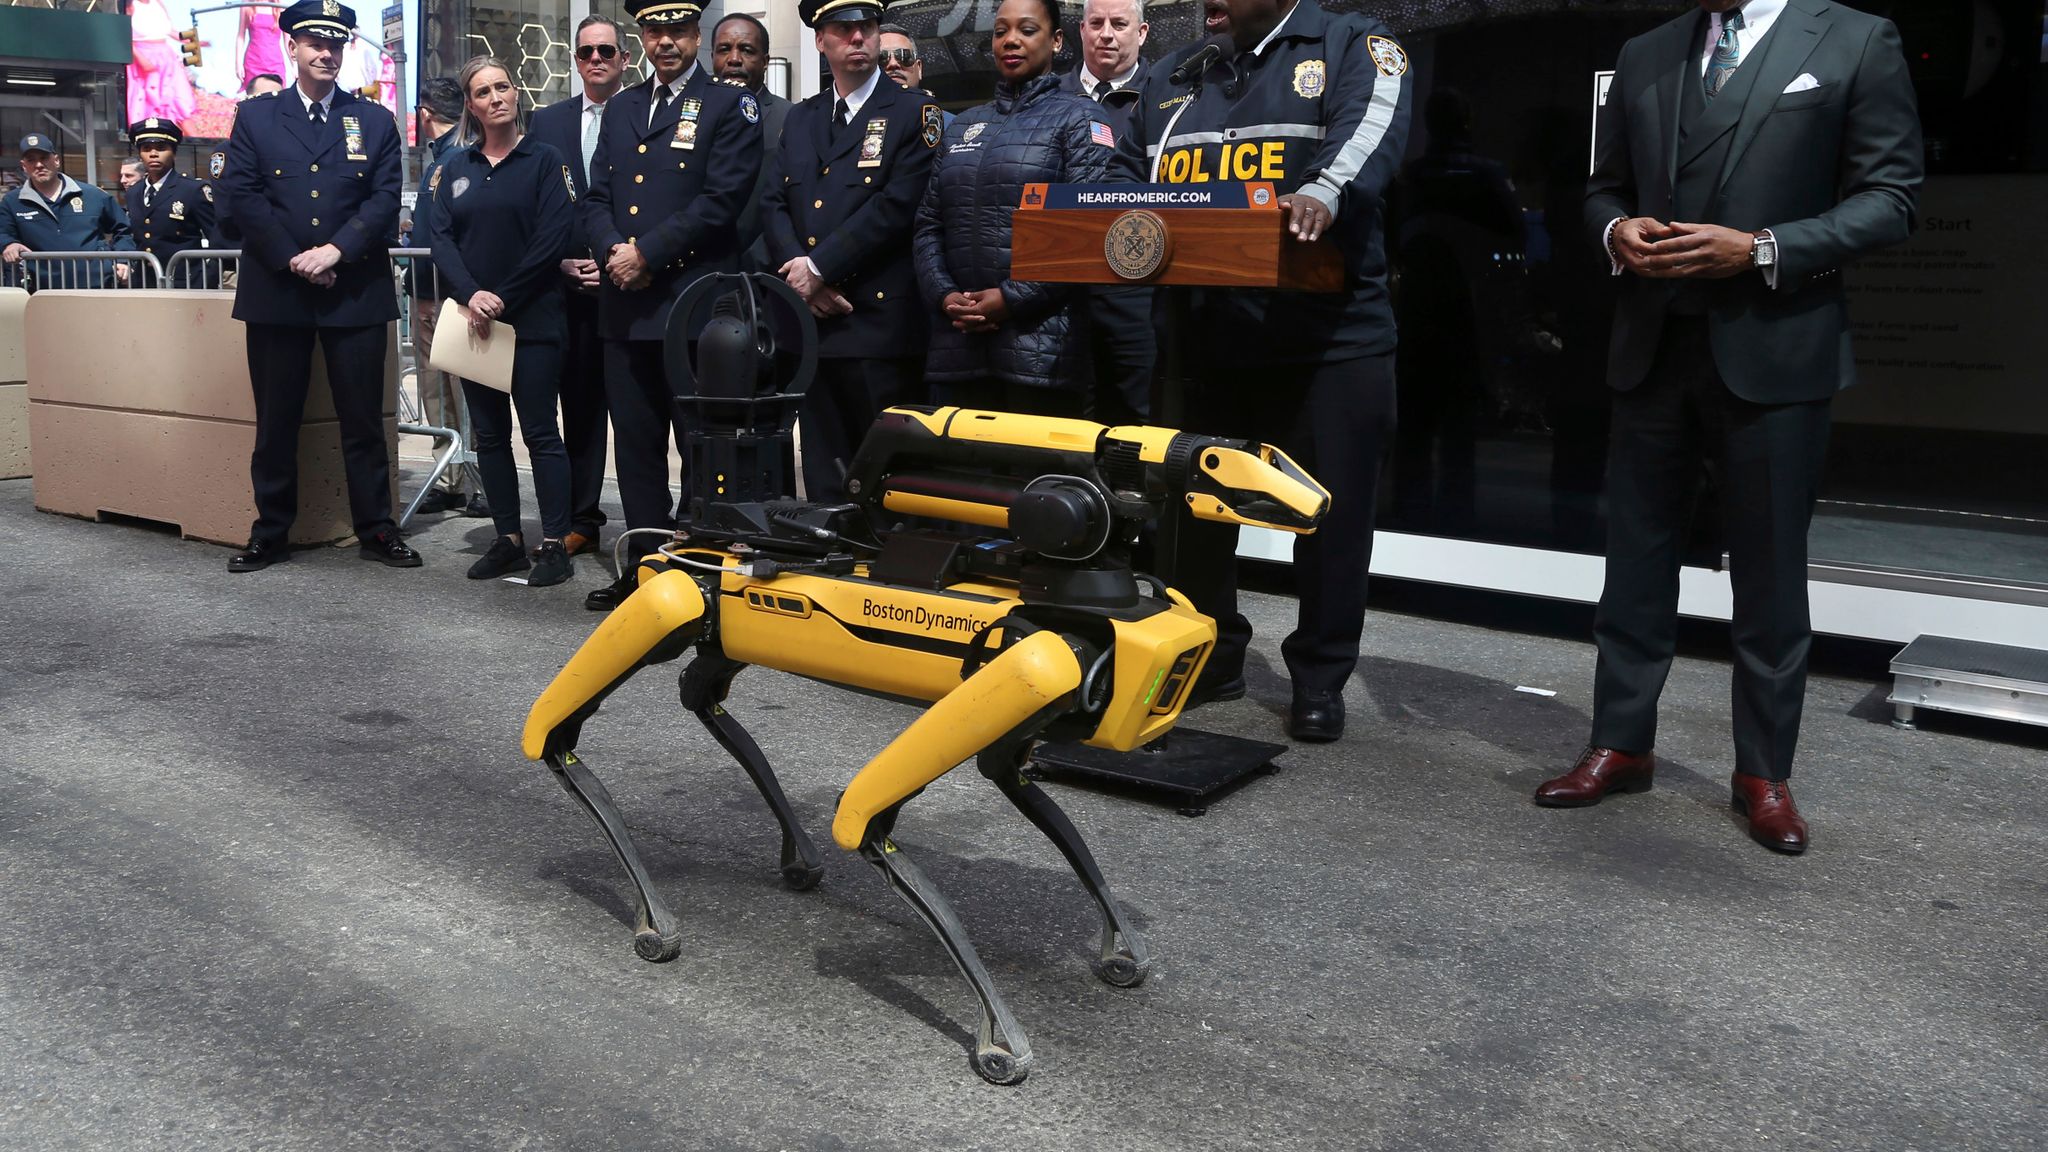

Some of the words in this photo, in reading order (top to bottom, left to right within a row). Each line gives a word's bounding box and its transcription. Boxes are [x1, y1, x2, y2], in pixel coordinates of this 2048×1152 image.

[1159, 141, 1285, 184] POLICE
[1077, 192, 1211, 203] HEARFROMERIC.COM
[1925, 217, 1973, 231] Start
